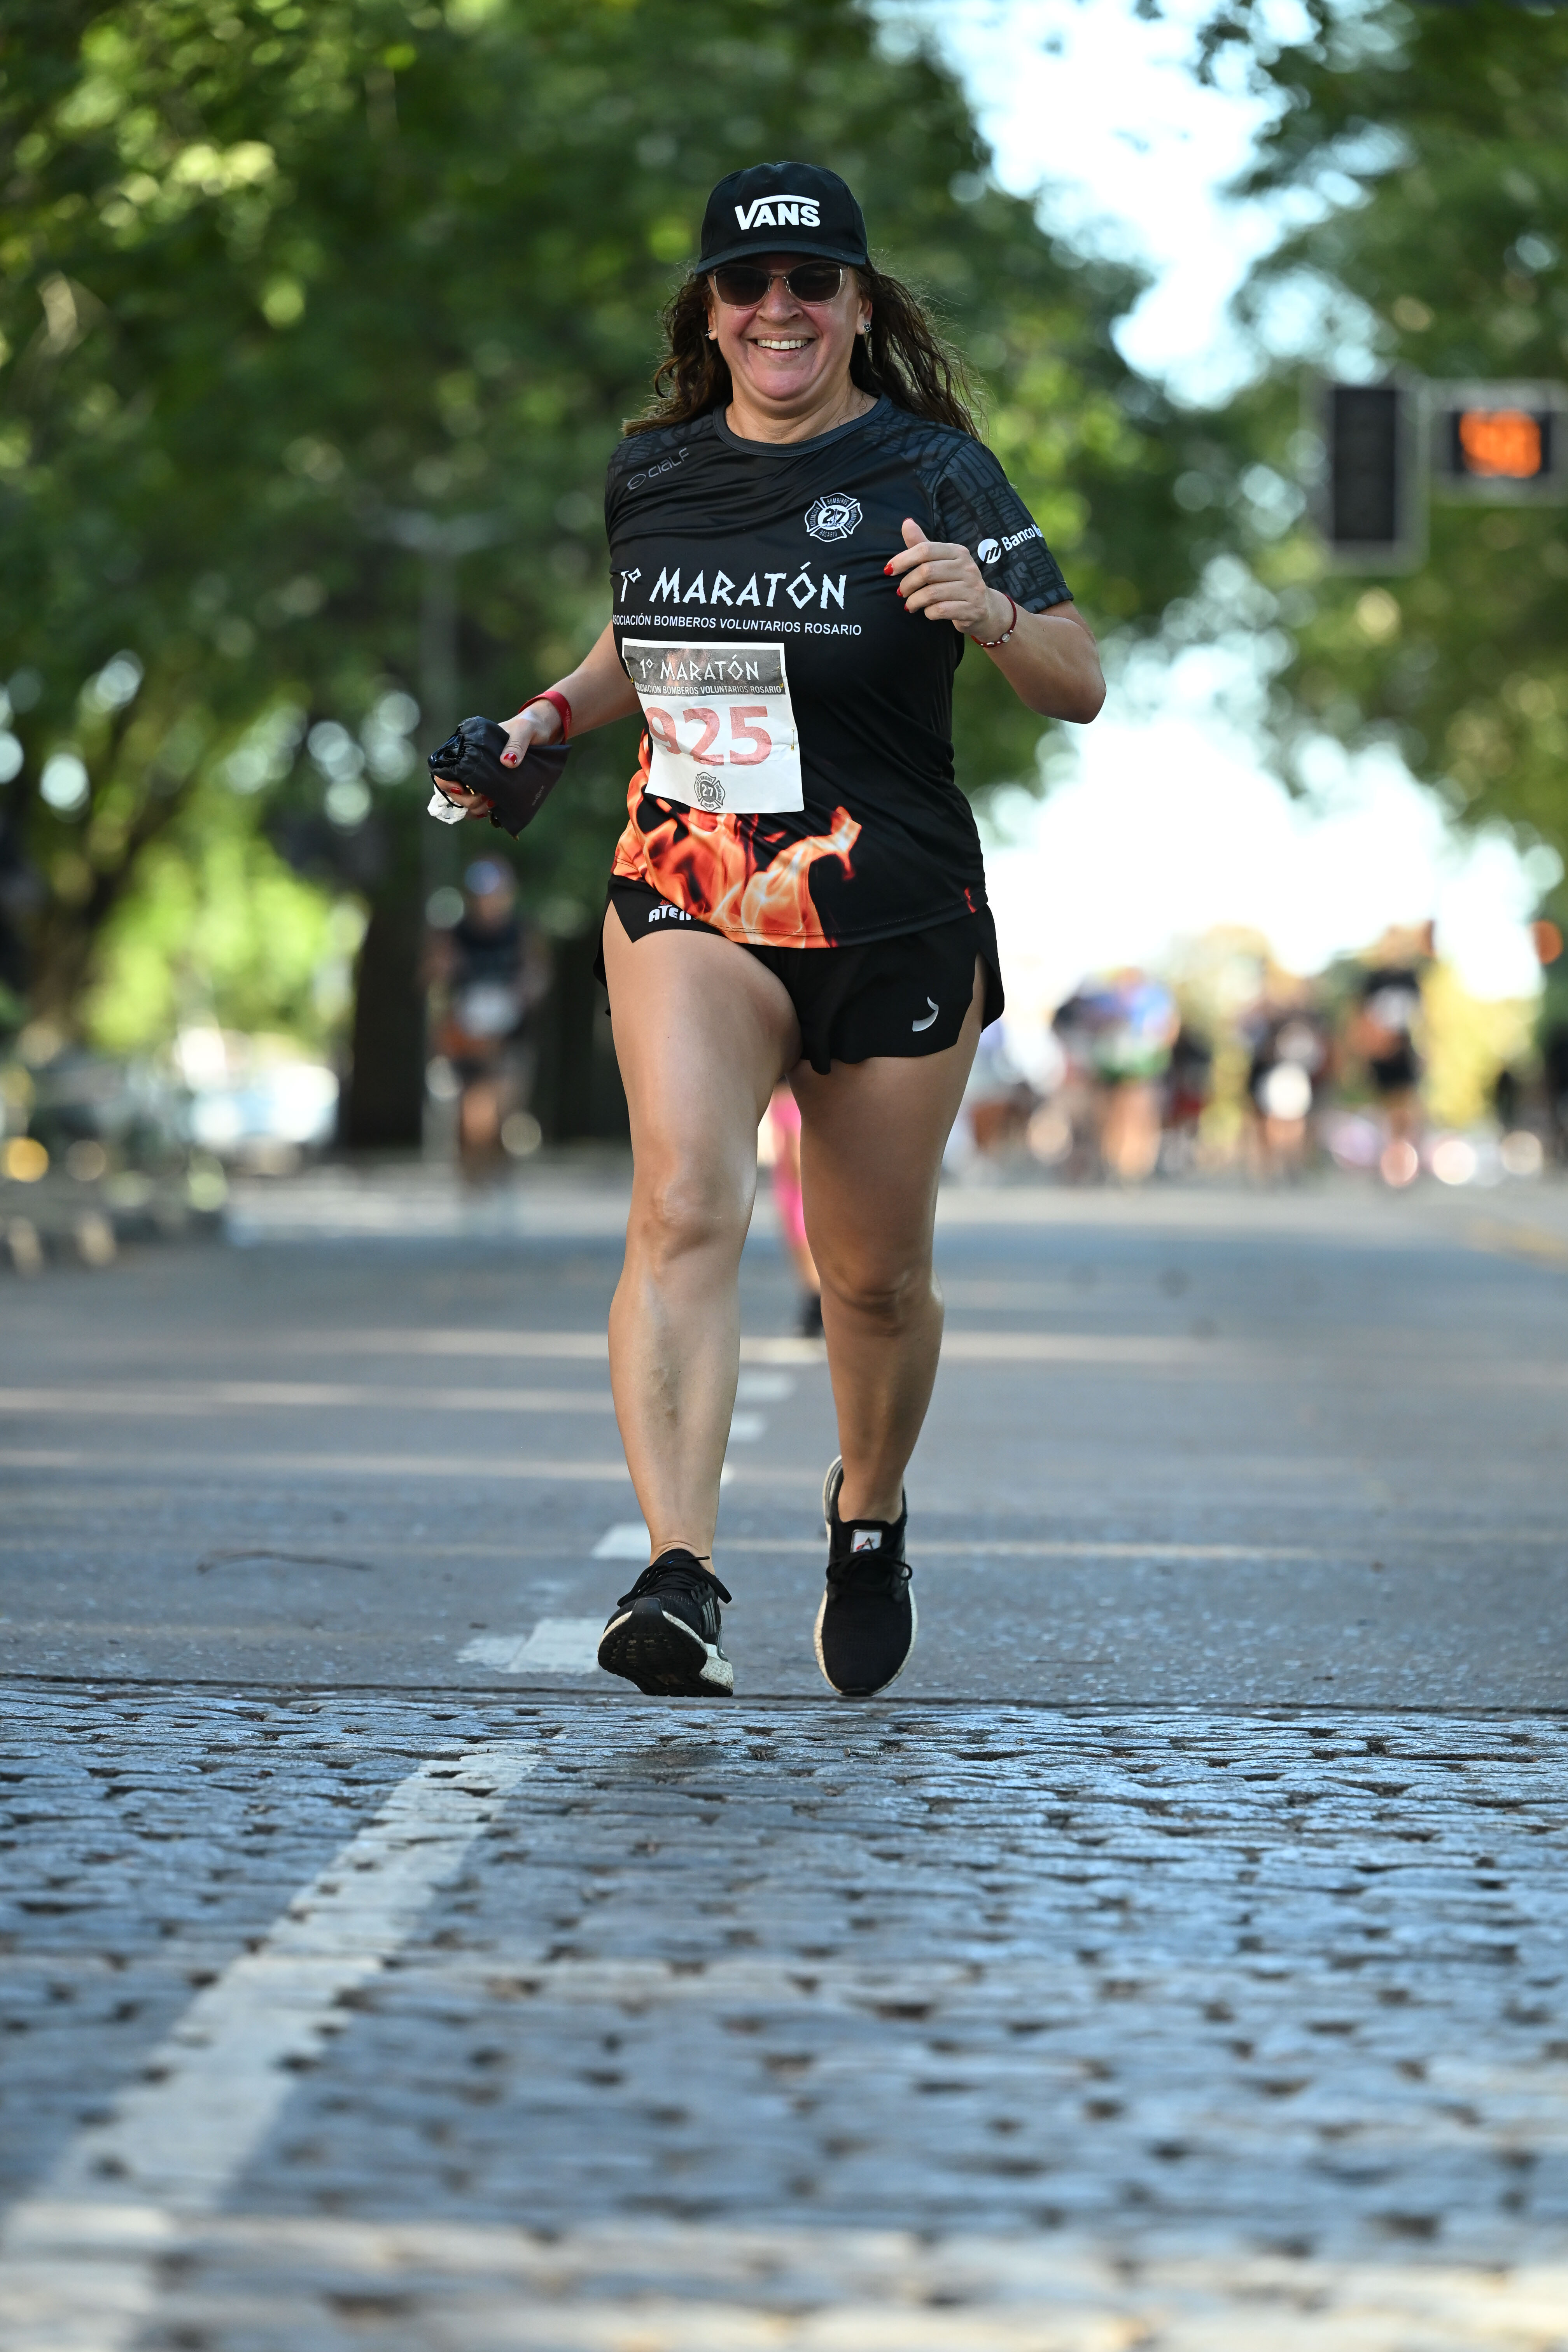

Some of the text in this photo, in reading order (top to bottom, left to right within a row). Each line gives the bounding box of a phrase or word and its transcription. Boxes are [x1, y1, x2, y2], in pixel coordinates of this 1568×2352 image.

[735, 195, 820, 230] VANS
[822, 508, 846, 524] 27
[649, 561, 847, 610] MARATÓN
[612, 613, 862, 635] ASOCIACIÓN BOMBEROS VOLUNTARIOS ROSARIO
[660, 654, 760, 681] MARATÓN
[634, 682, 661, 694] ASOCIACIÓN
[663, 686, 699, 695] BOMBEROS
[700, 686, 749, 694] VOLUNTARIOS
[644, 706, 772, 766] 925
[702, 784, 714, 796] 27
